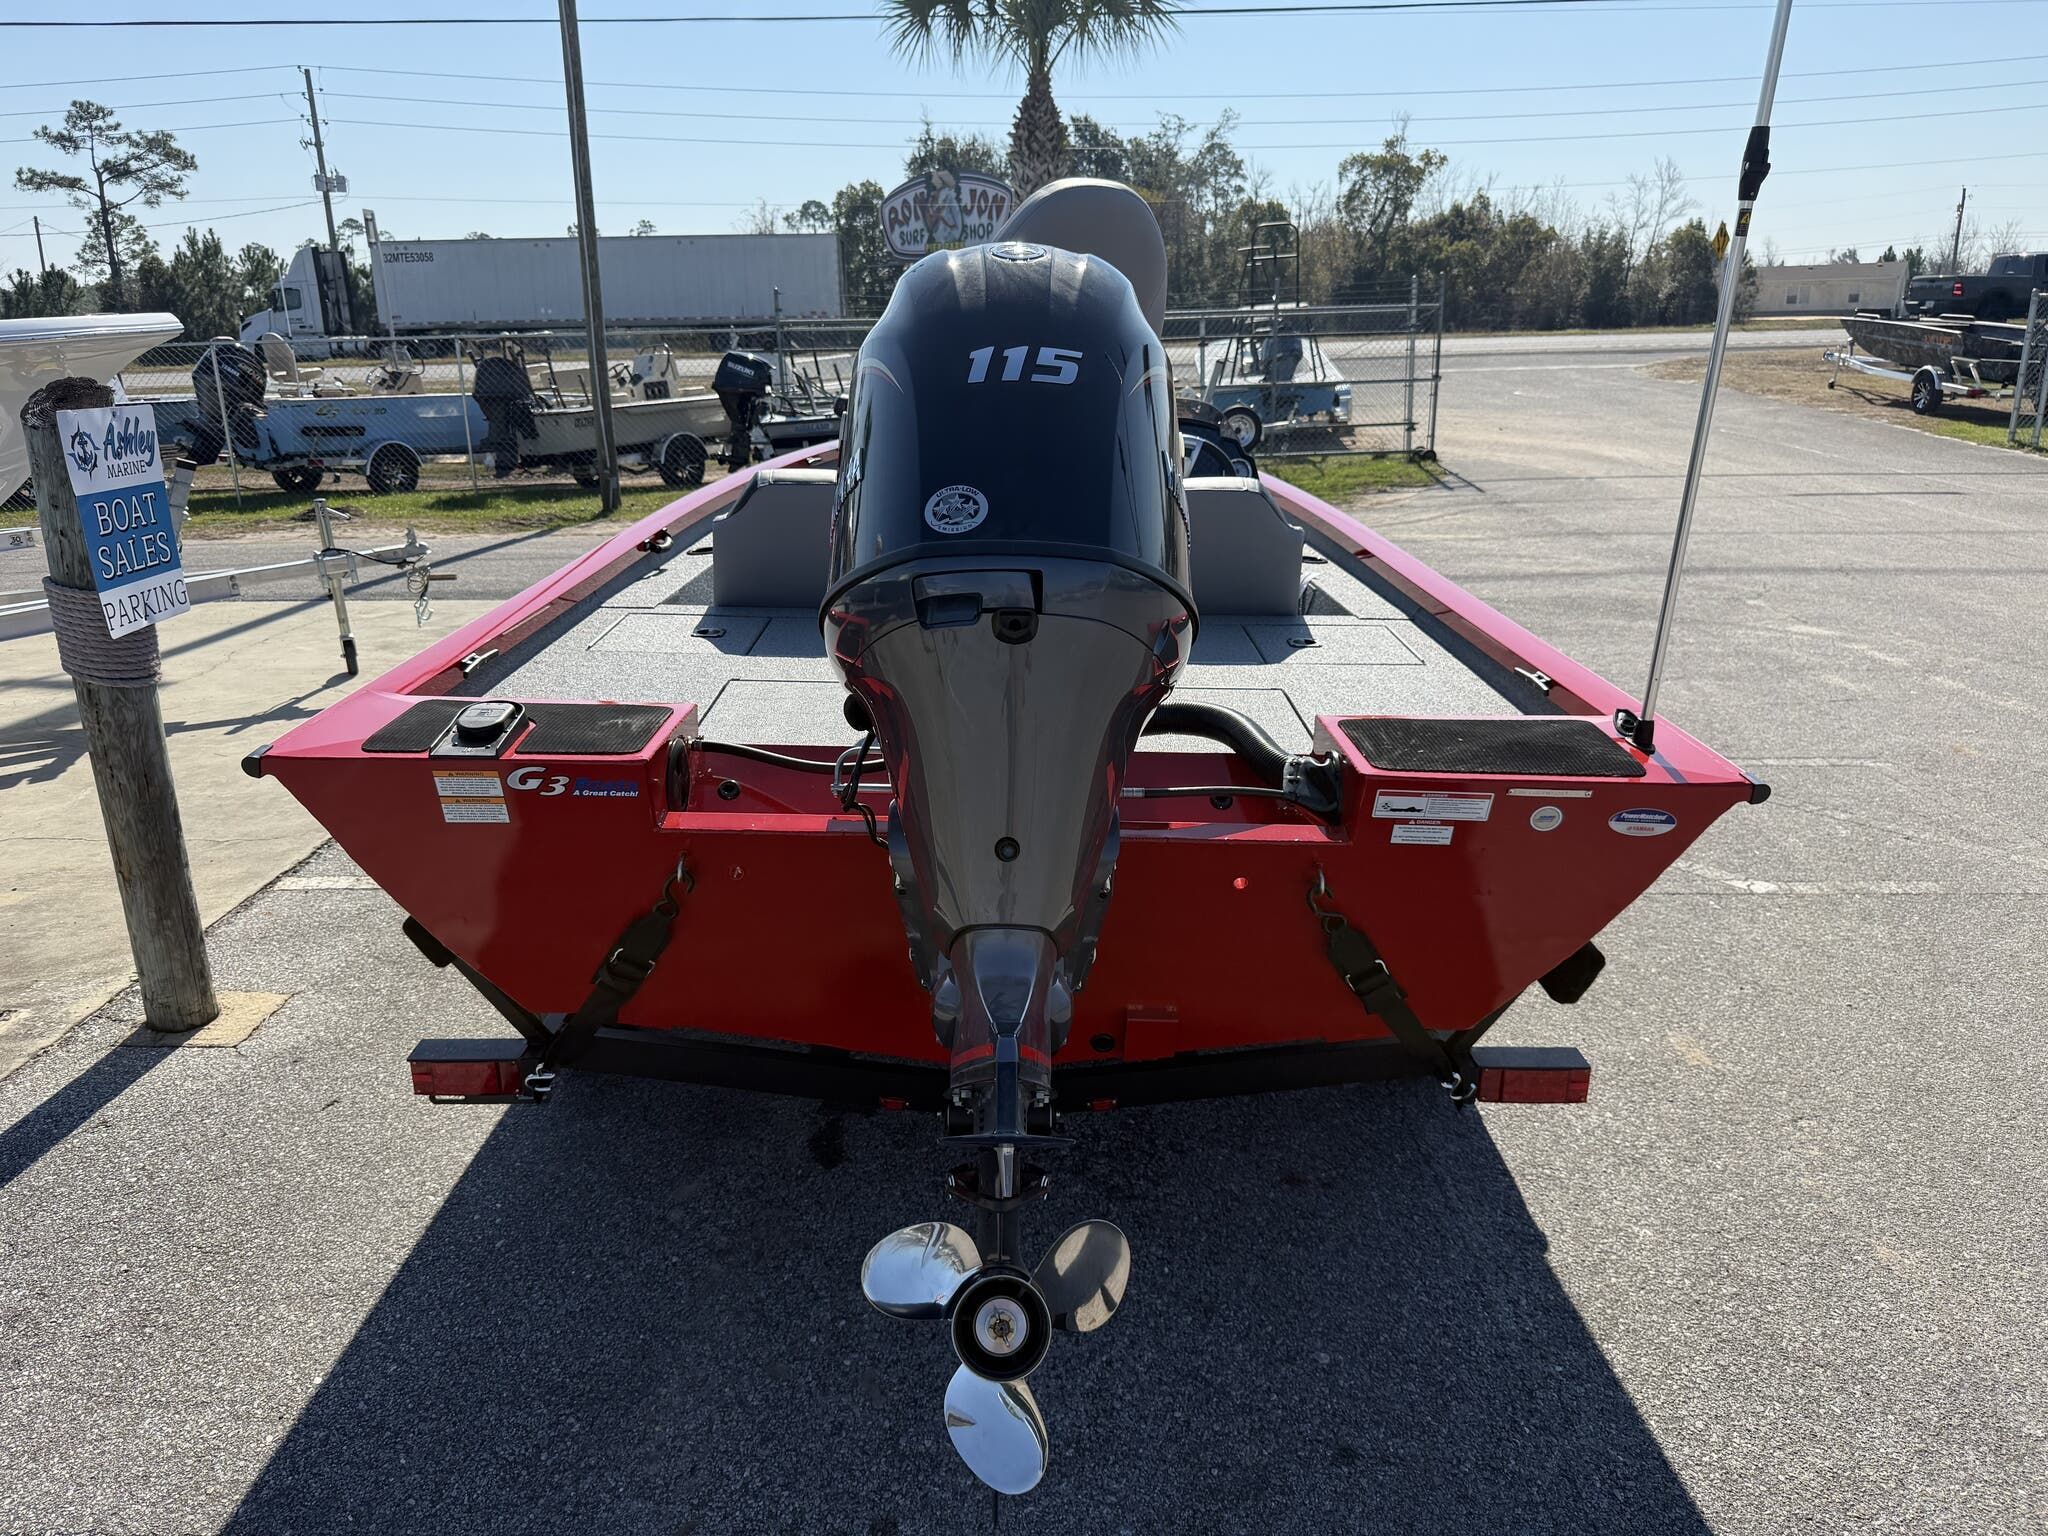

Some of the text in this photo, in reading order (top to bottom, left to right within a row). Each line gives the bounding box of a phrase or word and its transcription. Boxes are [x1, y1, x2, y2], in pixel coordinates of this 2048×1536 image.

[888, 188, 1006, 235] RON JON
[899, 227, 925, 246] SURF
[963, 223, 994, 240] SHOP
[967, 345, 1084, 385] 115
[103, 416, 155, 467] Ashley
[107, 460, 147, 478] MARINE
[94, 492, 158, 537] BOAT
[98, 532, 172, 580] SALES
[103, 579, 188, 632] PARKING
[506, 766, 570, 796] G3
[582, 789, 607, 797] Great
